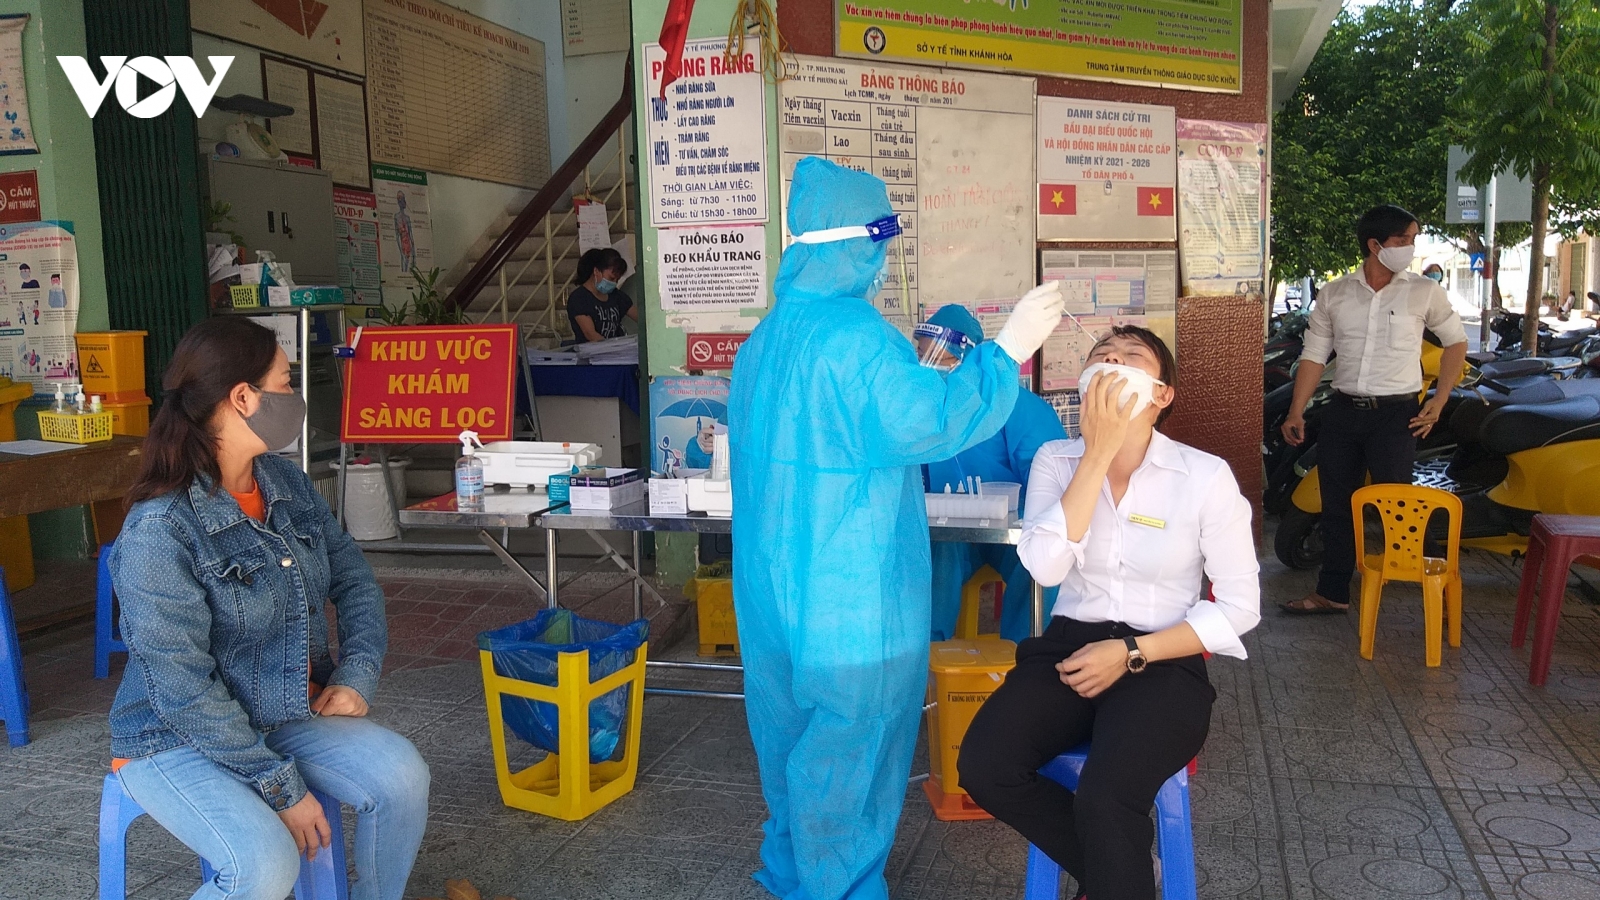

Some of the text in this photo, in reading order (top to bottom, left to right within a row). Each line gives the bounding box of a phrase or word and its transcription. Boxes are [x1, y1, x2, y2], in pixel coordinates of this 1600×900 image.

[930, 45, 936, 53] Y
[937, 44, 947, 54] TẾ
[969, 48, 995, 60] KHÁNH
[1086, 62, 1109, 72] TRUNG
[1110, 62, 1124, 73] TÂM
[1126, 63, 1152, 76] TRUYỀN
[1154, 67, 1175, 78] THÔNG
[1176, 69, 1192, 80] GIÁO
[860, 68, 966, 96] BẢNG THÔNG BÁO
[844, 89, 857, 98] Lịch
[878, 92, 891, 102] ngày
[904, 94, 919, 104] tháng
[784, 97, 822, 112] Ngày tháng
[784, 112, 824, 125] Tiêm vacxin
[831, 110, 861, 122] Vacxin
[877, 107, 896, 119] Tháng
[1067, 108, 1151, 123] DANH SÁCH CỬ TRI
[881, 119, 892, 130] của
[1064, 121, 1153, 140] BẦU ĐẠI BIỂU QUỐC HỘI
[834, 136, 849, 147] Lao
[874, 133, 898, 146] Tháng
[1044, 137, 1171, 155] VÀ HỘI ĐỒNG NHÂN DÂN CÁC CẤP
[654, 135, 670, 171] HIỆN
[879, 149, 910, 158] sau sinh
[1066, 154, 1150, 167] NHIỆM KỲ 2021 2026
[882, 167, 899, 178] tháng
[1094, 170, 1110, 179] DÂN
[1112, 170, 1127, 179] PHỐ
[10, 184, 32, 197] CẤM
[663, 178, 753, 193] THỜI GIAN LÀM VIỆC:
[660, 194, 756, 208] Sáng: từ 7h30 11h00
[890, 193, 903, 205] tháng
[661, 207, 757, 219] Chiều: từ 15h30 18h00
[680, 230, 744, 245] THÔNG BÁO
[664, 247, 761, 264] ĐEO KHẨU TRANG
[371, 335, 492, 364] KHU VỰC
[714, 353, 725, 362] HÚT
[388, 368, 469, 394] KHÁM
[358, 402, 496, 430] SÀNG LỌC
